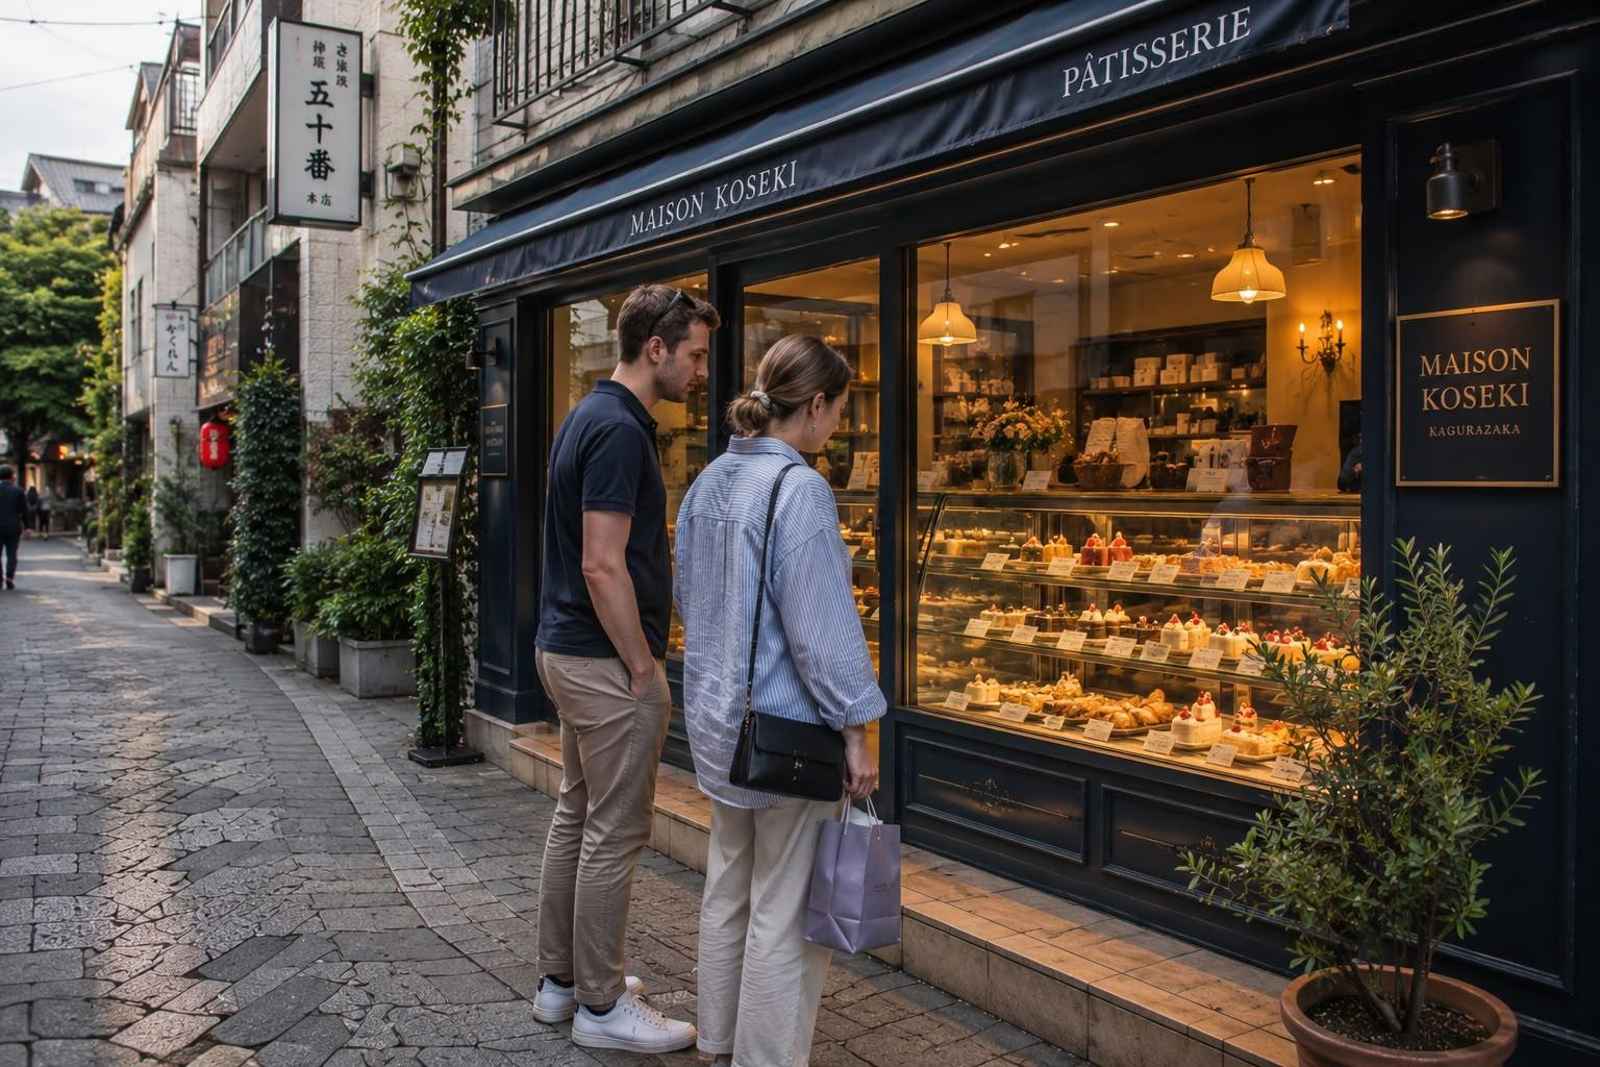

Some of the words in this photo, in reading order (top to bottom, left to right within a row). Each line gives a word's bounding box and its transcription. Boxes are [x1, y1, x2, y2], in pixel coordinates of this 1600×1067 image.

[1062, 6, 1250, 99] PÂTISSERIE
[304, 80, 335, 181] 五十番
[630, 192, 705, 236] MAISON
[715, 159, 798, 210] KOSEKI
[1419, 347, 1532, 377] MAISON
[1422, 383, 1529, 411] KOSEKI
[1429, 424, 1521, 437] KAGURAZAKA
